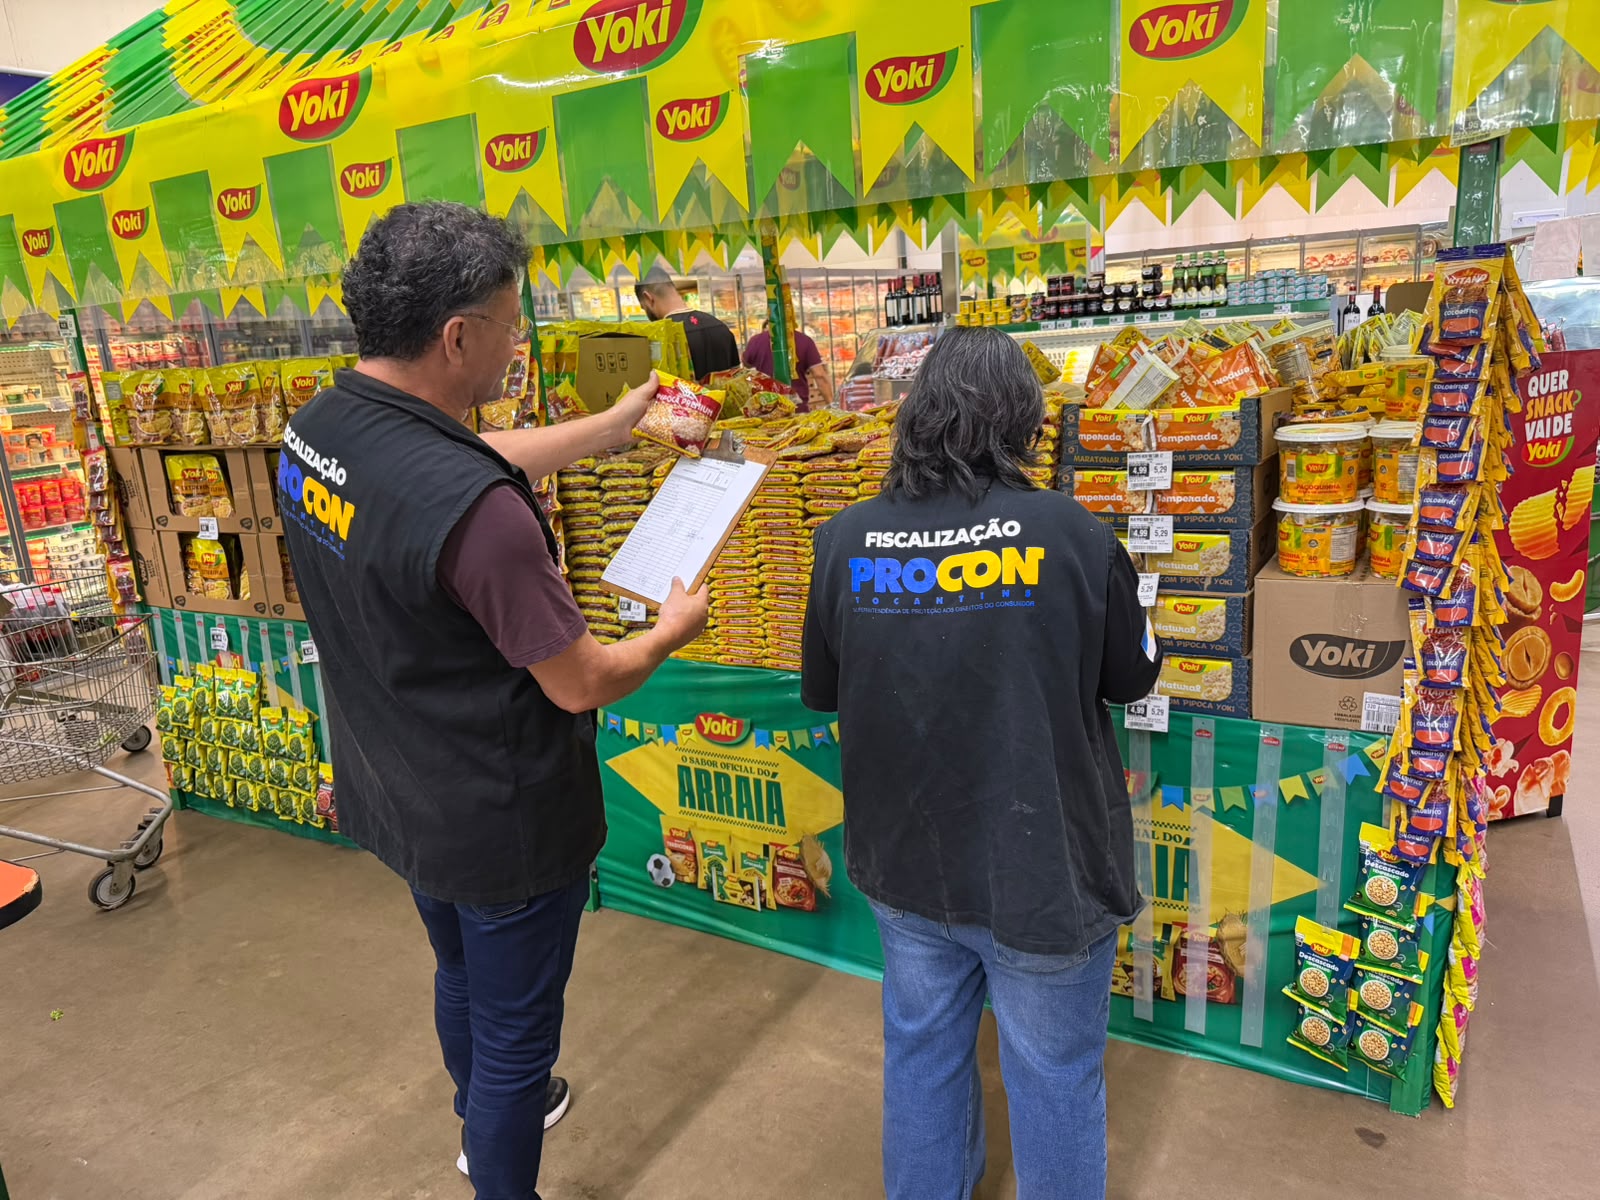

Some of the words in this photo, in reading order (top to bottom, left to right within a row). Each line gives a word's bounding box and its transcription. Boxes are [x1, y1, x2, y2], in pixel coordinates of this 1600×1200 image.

[586, 0, 671, 62] Yoki
[1140, 3, 1219, 52] Yoki
[873, 59, 934, 97] Yoki
[287, 81, 349, 130] Yoki
[662, 104, 711, 134] Yoki
[71, 140, 117, 182] Yoki
[490, 136, 532, 165] Yoki
[344, 165, 380, 190] Yoki
[220, 191, 251, 215] Yoki
[115, 212, 141, 235] Yoki
[24, 230, 48, 254] Yoki
[1528, 370, 1569, 398] QUER
[681, 398, 713, 416] PREMIUM
[1526, 390, 1582, 421] SNACK?
[1095, 414, 1112, 423] Yoki
[1186, 414, 1205, 423] Yoki
[1525, 417, 1551, 442] VAI
[1555, 413, 1572, 436] DE
[1079, 433, 1121, 442] mperada
[1157, 432, 1218, 443] Temperada
[284, 422, 346, 486] SCALIZAÇÃO
[1074, 455, 1119, 463] MARATONAR
[1224, 453, 1243, 461] YOKI
[1526, 440, 1562, 461] Yoki
[1095, 475, 1111, 484] Yoki
[1184, 475, 1202, 484] Yoki
[278, 450, 355, 541] ROCON
[1073, 493, 1123, 502] emperada
[865, 518, 1021, 548] FISCALIZAÇÃO
[1178, 541, 1197, 551] Yoki
[849, 547, 1045, 594] PROCON
[1157, 561, 1200, 571] Natural
[1214, 578, 1233, 586] YOKI
[855, 589, 1032, 605] TOCANTINS
[1176, 603, 1196, 613] Yoki
[1177, 641, 1207, 649] PIPOCA
[1210, 643, 1229, 652] YOKI
[1301, 639, 1376, 669] Yoki
[1181, 661, 1200, 671] Yoki
[1183, 701, 1214, 710] PIPOCA
[1216, 703, 1235, 712] YOKI
[699, 716, 737, 737] Yoki
[681, 755, 688, 763] O
[689, 756, 718, 768] SABOR
[720, 761, 755, 777] OFICIAL
[757, 769, 771, 777] DO
[677, 764, 786, 828] ARRAIÁ
[1163, 832, 1182, 843] DO
[1381, 850, 1397, 860] Yoki
[1365, 859, 1409, 878] Descascado
[1313, 944, 1329, 954] Yoki
[1299, 951, 1339, 972] Descascado
